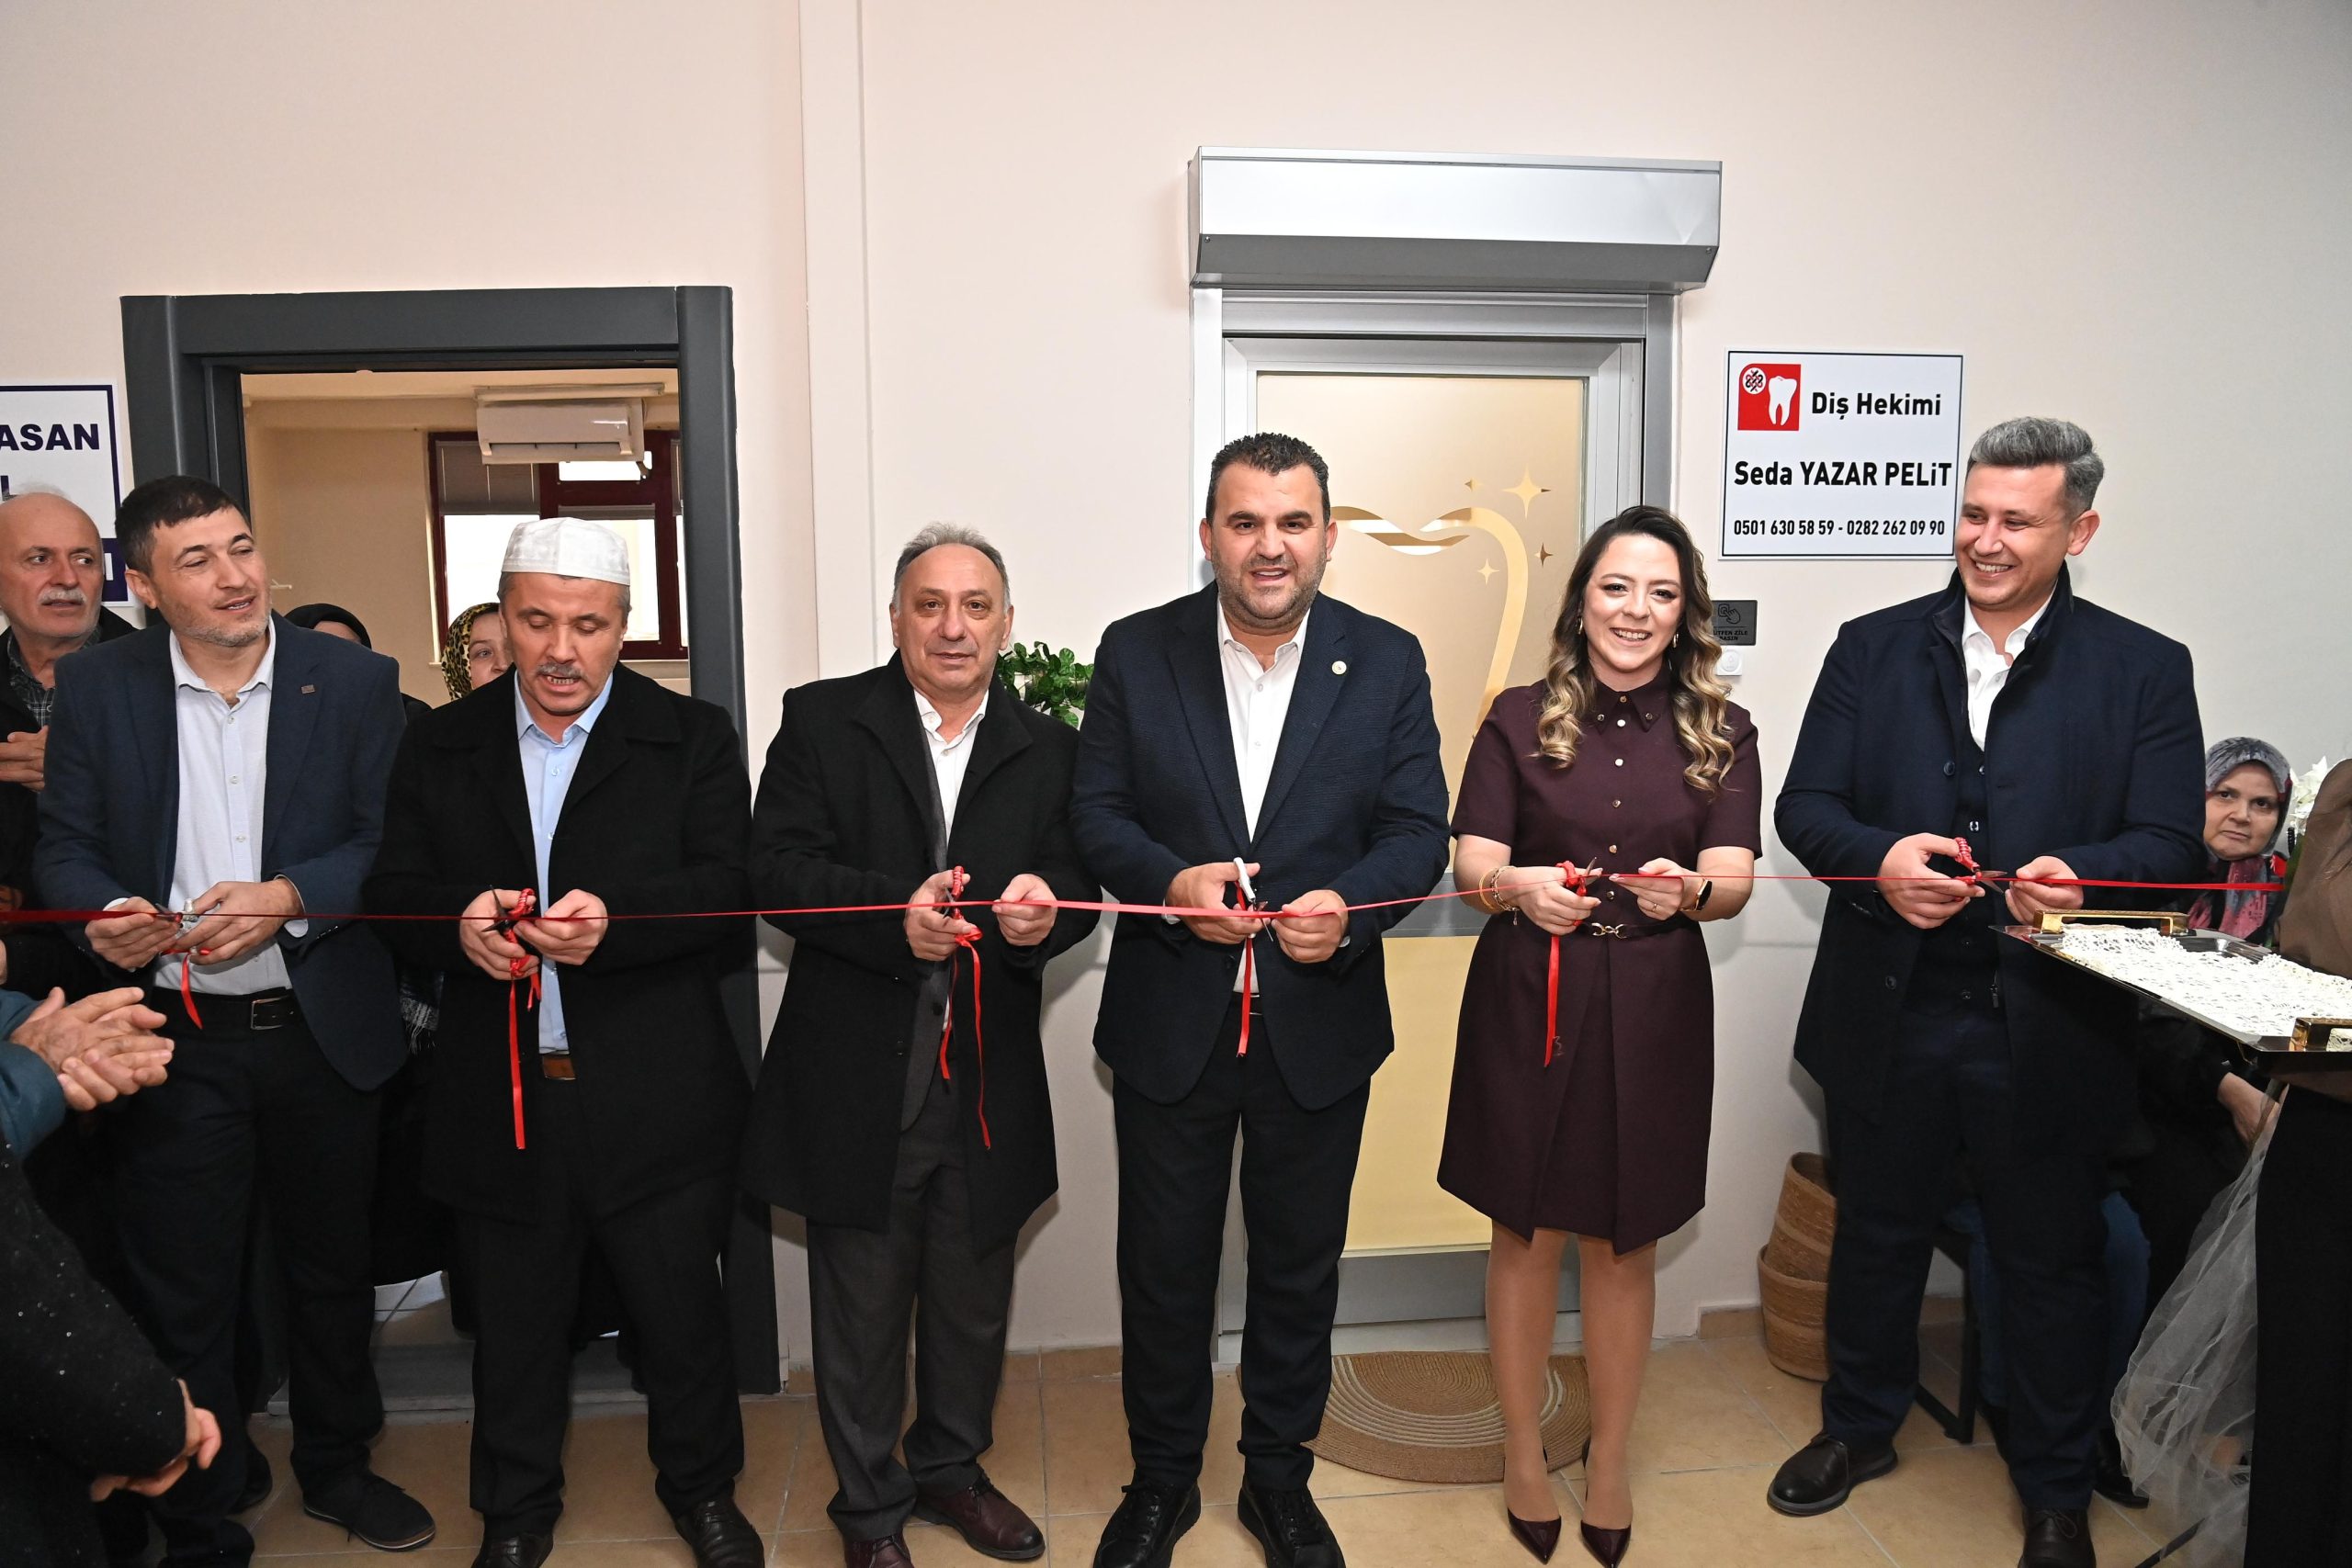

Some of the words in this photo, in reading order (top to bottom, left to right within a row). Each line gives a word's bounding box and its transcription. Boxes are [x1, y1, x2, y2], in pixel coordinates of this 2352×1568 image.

[1812, 392, 1849, 420] Diş
[1856, 392, 1941, 416] Hekimi
[1734, 460, 1792, 486] Seda
[1799, 461, 1878, 486] YAZAR
[1734, 519, 1766, 536] 0501
[1770, 519, 1795, 536] 630
[1798, 519, 1815, 536] 58
[1818, 519, 1835, 536] 59
[1847, 520, 1880, 536] 0282
[1883, 520, 1906, 536] 262
[1909, 520, 1926, 536] 09
[1929, 520, 1945, 536] 90
